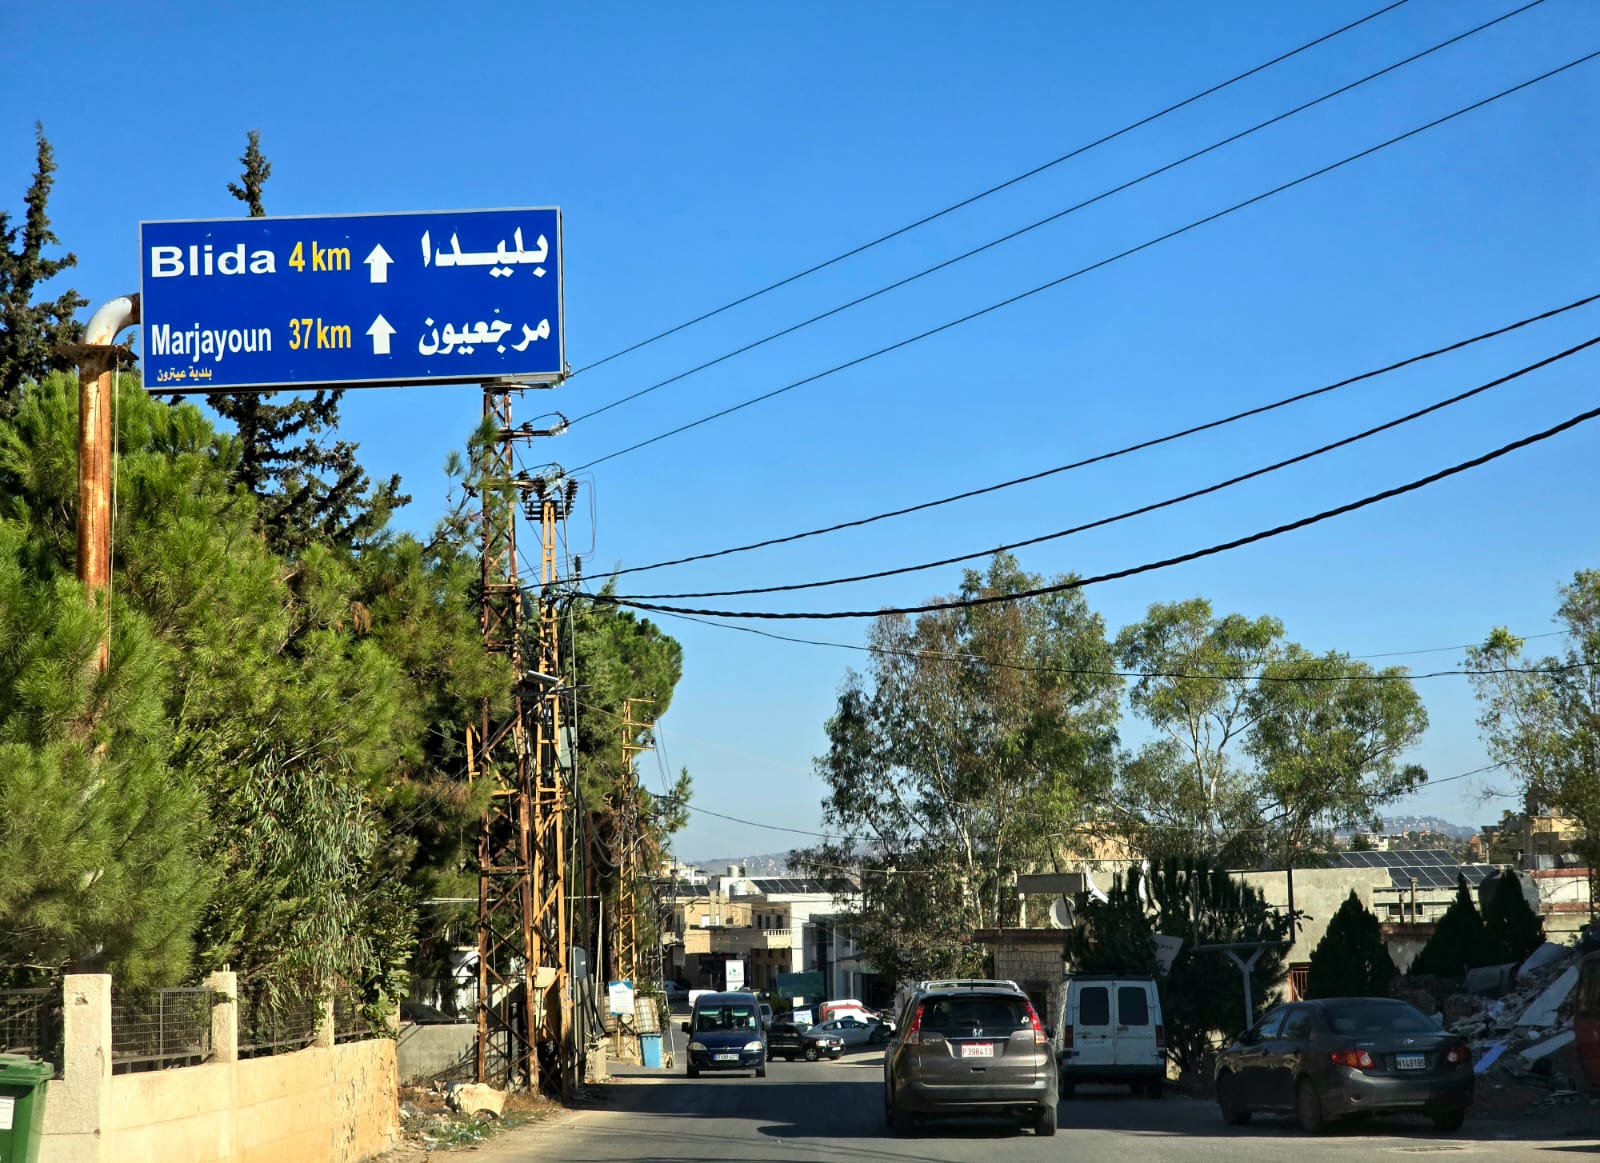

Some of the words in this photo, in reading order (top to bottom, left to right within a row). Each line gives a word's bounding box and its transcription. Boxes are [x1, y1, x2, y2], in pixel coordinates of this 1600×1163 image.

[151, 243, 277, 278] Blida
[288, 241, 306, 272] 4
[312, 240, 351, 272] km
[421, 226, 549, 278] بليدا
[151, 322, 272, 363] Marjayoun
[288, 318, 314, 350] 37
[316, 317, 352, 349] km
[418, 308, 551, 356] مرجعيون
[188, 365, 213, 381] بلدية
